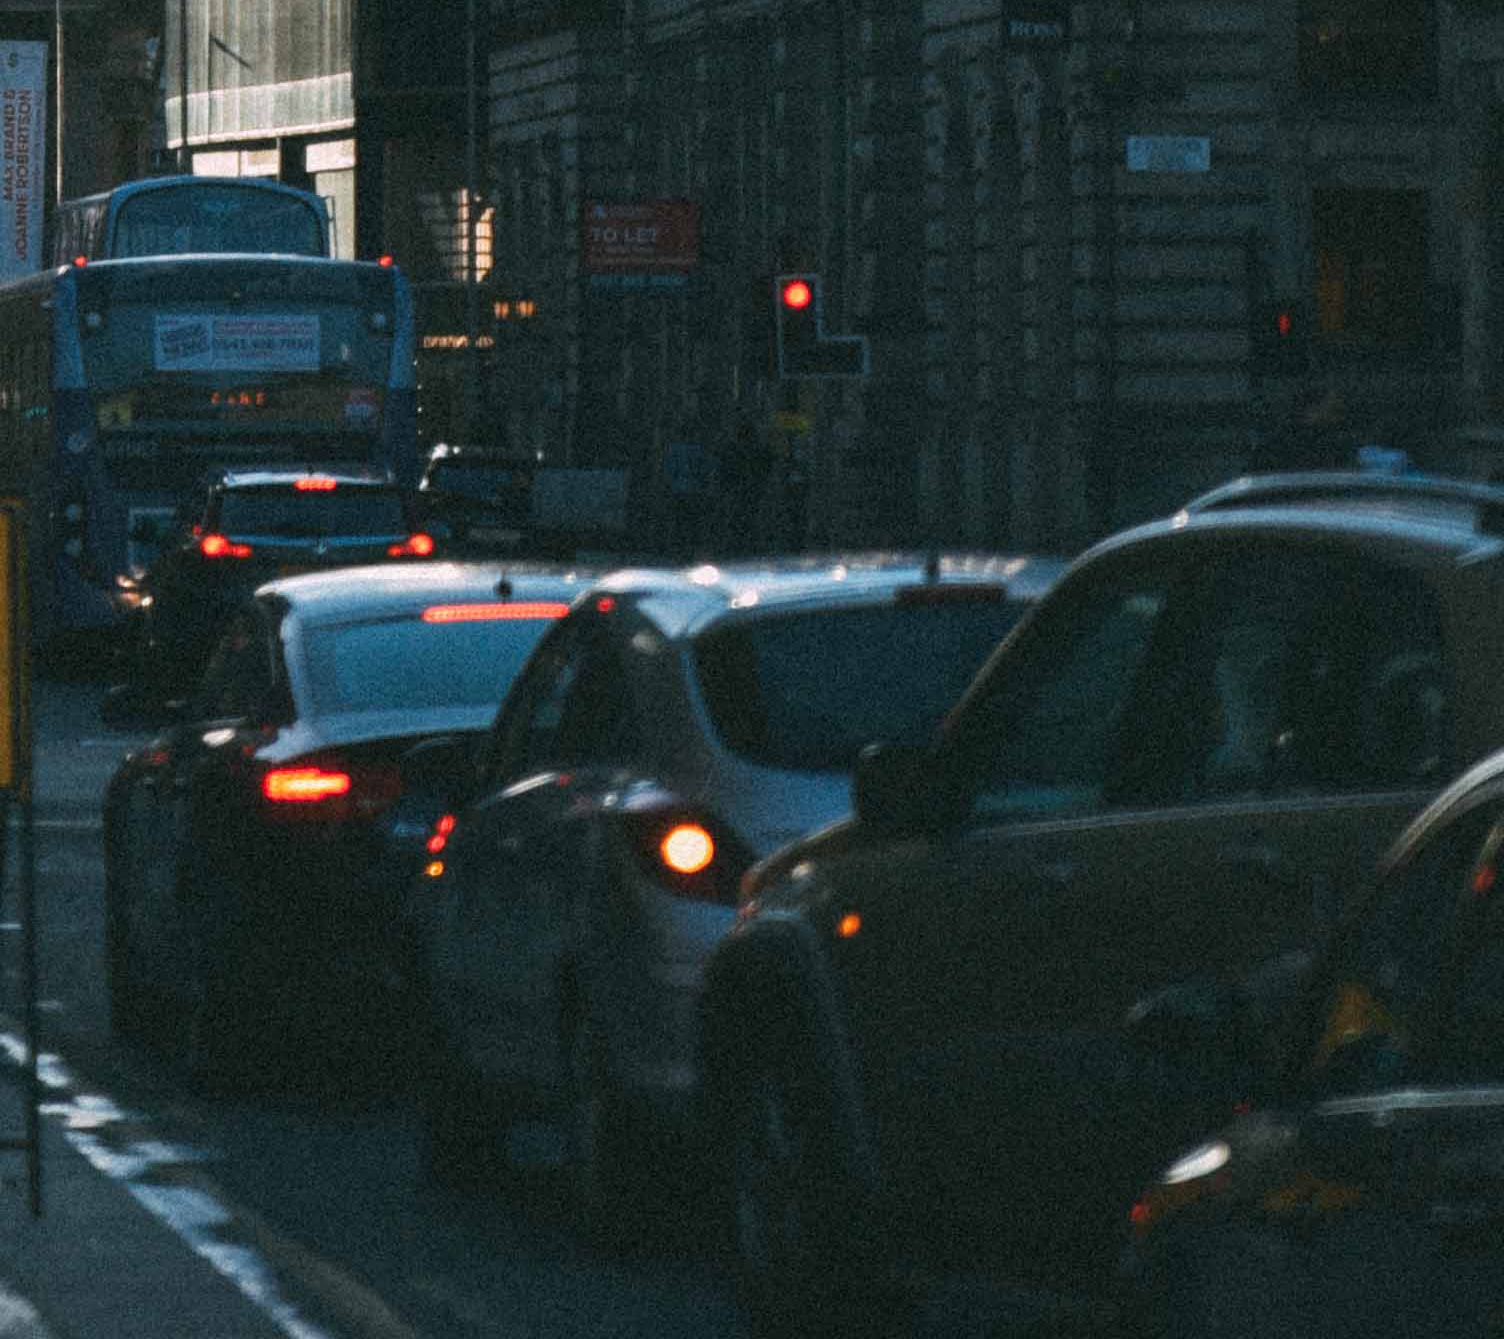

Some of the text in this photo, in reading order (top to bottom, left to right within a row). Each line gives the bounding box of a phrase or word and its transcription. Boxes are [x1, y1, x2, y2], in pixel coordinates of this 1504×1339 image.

[3, 103, 15, 161] BRAND
[2, 165, 14, 203] MAX
[15, 89, 31, 261] JOANNE ROBERTSON
[590, 227, 658, 243] TO LET
